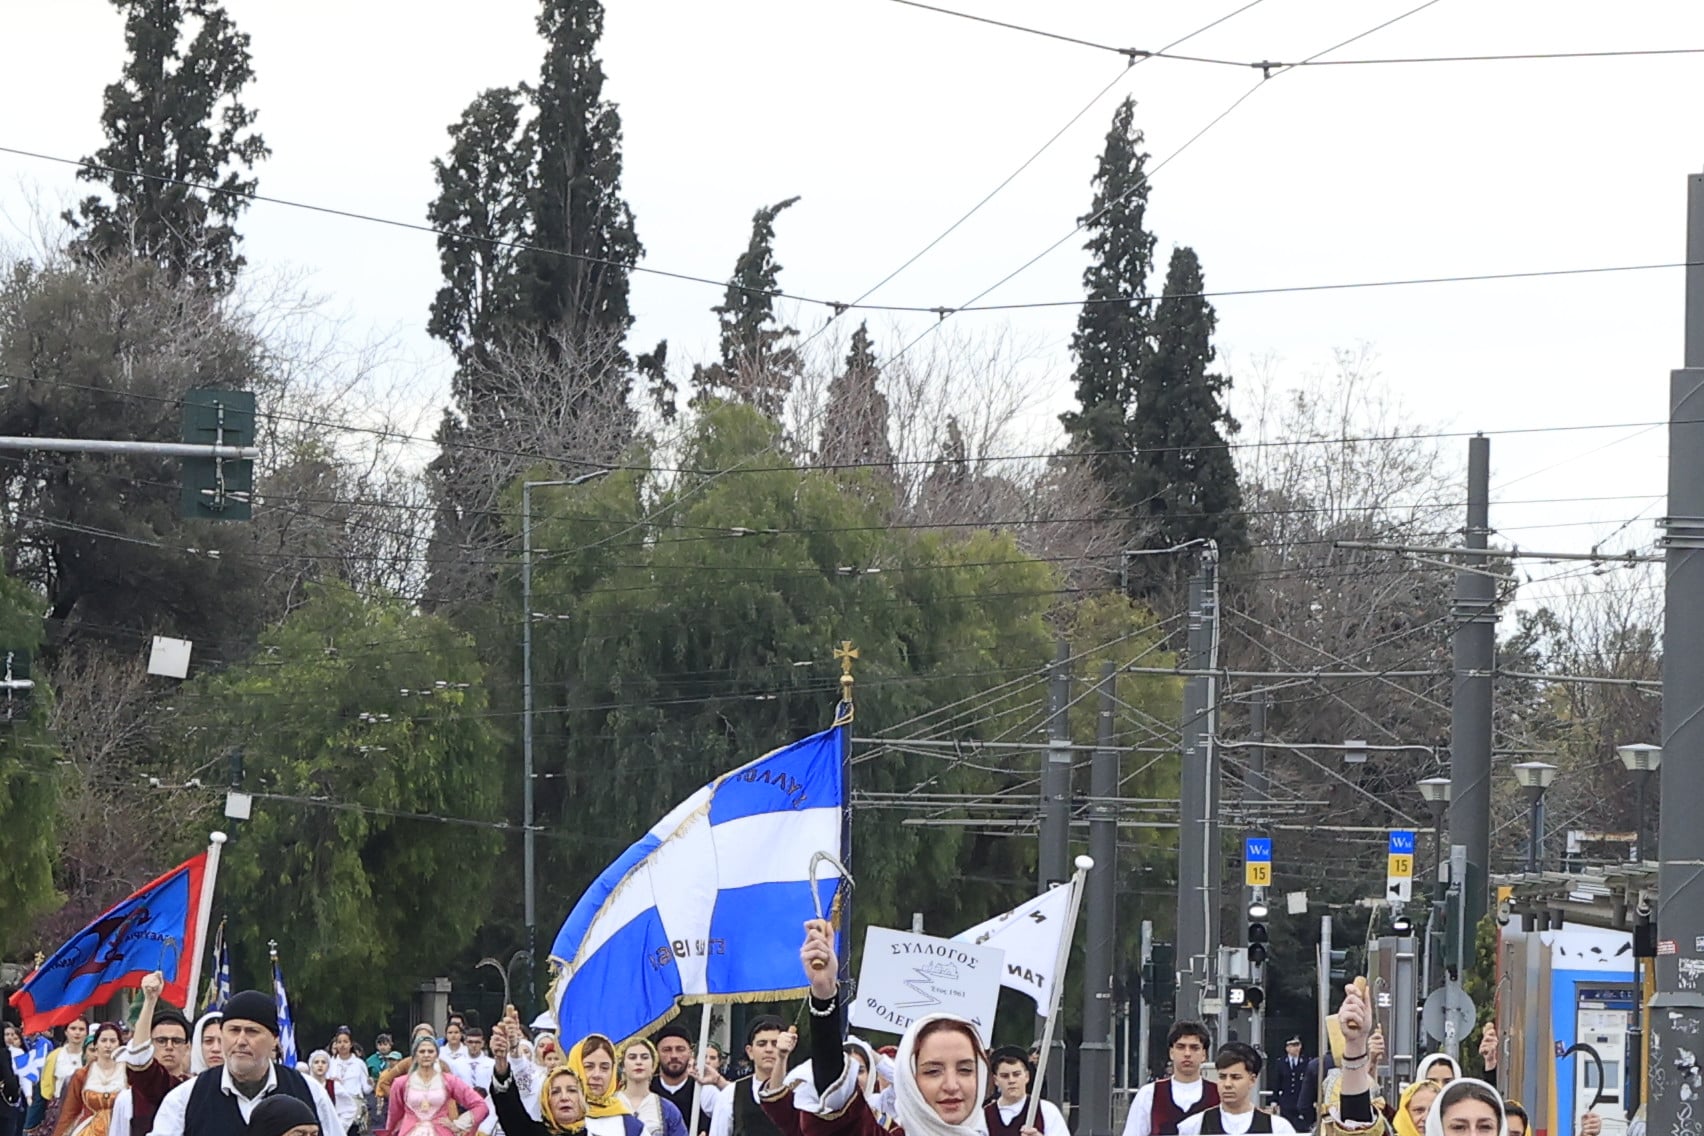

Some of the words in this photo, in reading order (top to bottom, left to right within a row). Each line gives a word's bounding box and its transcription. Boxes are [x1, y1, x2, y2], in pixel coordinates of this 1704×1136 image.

[1395, 859, 1408, 873] 15
[1253, 867, 1266, 880] 15
[890, 942, 979, 970] ΣΥΛΛΟΓΟΣ
